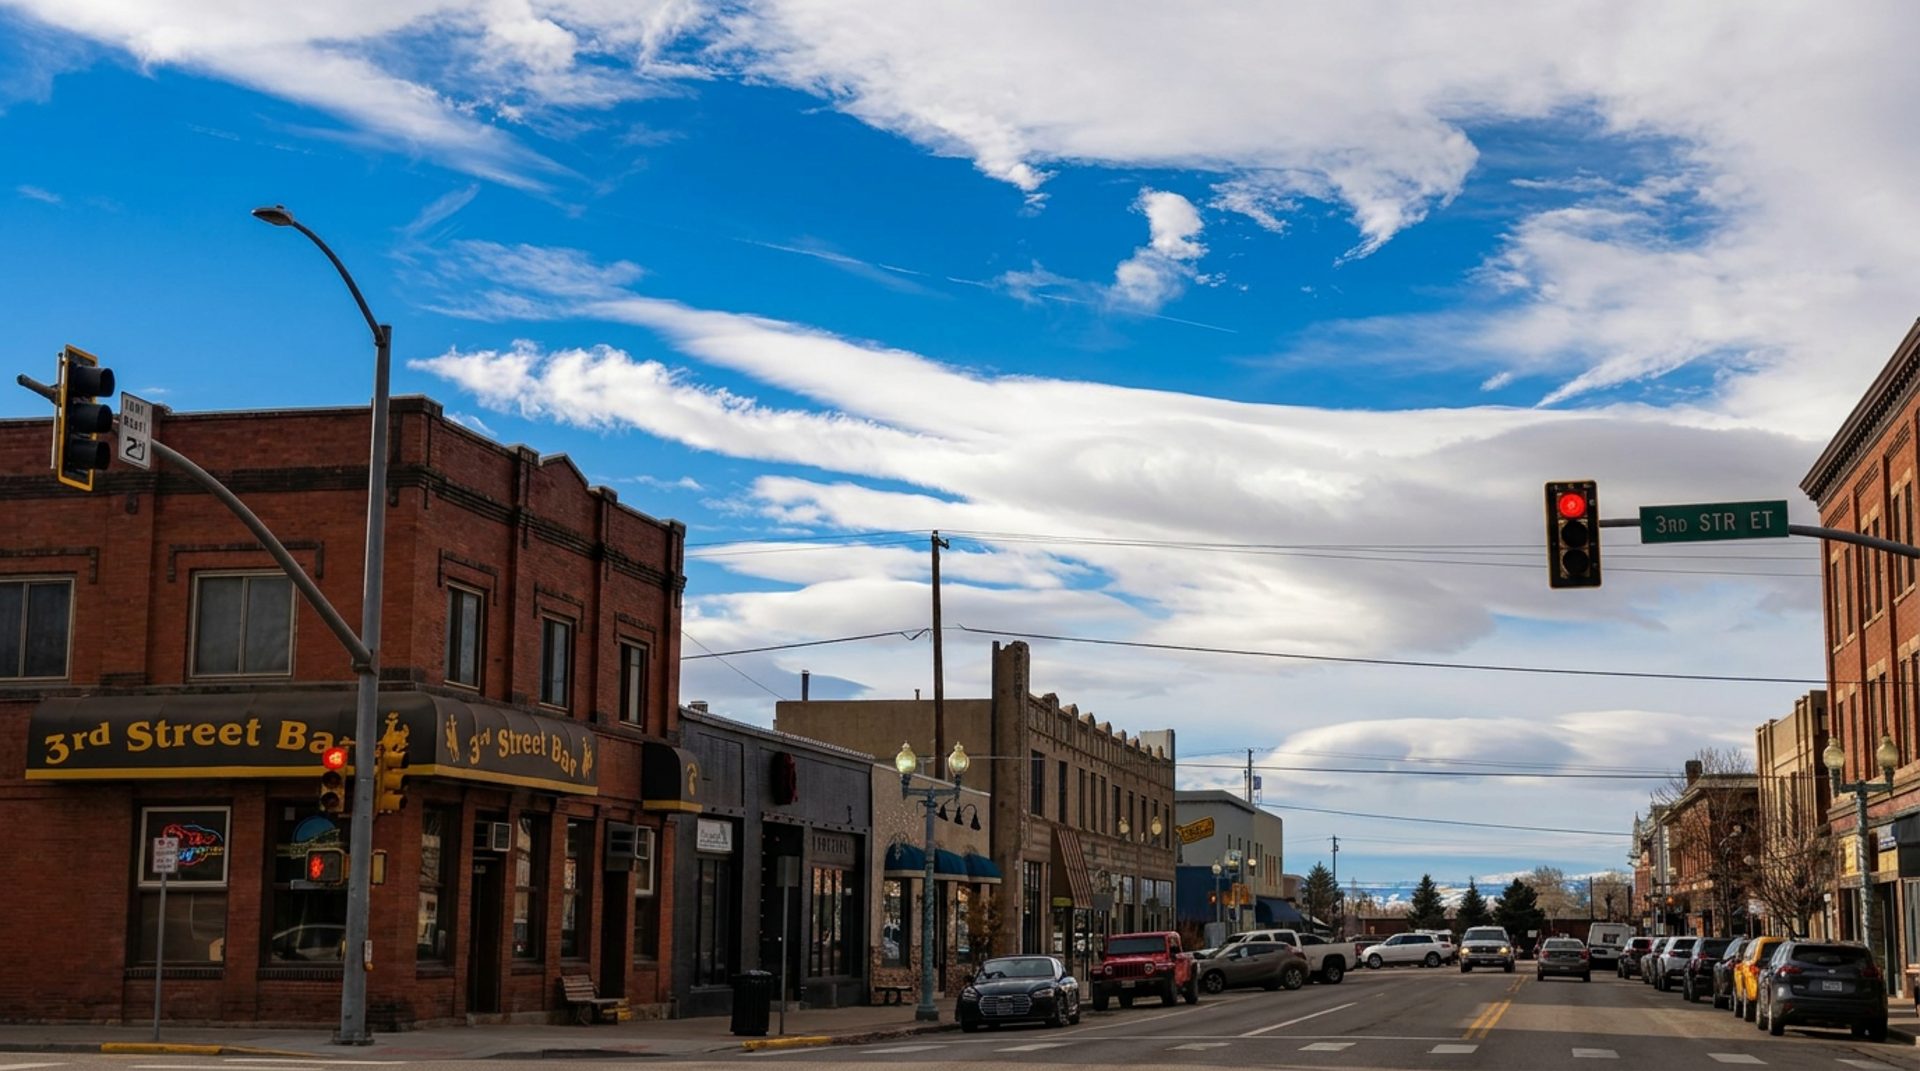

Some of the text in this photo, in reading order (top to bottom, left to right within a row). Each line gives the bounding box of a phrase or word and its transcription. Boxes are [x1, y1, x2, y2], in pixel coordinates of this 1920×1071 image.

[1699, 512, 1736, 532] STR
[1751, 510, 1774, 530] ET
[45, 721, 111, 765] 3rd
[127, 716, 260, 751] Street
[469, 727, 577, 778] 3rd Street Bar
